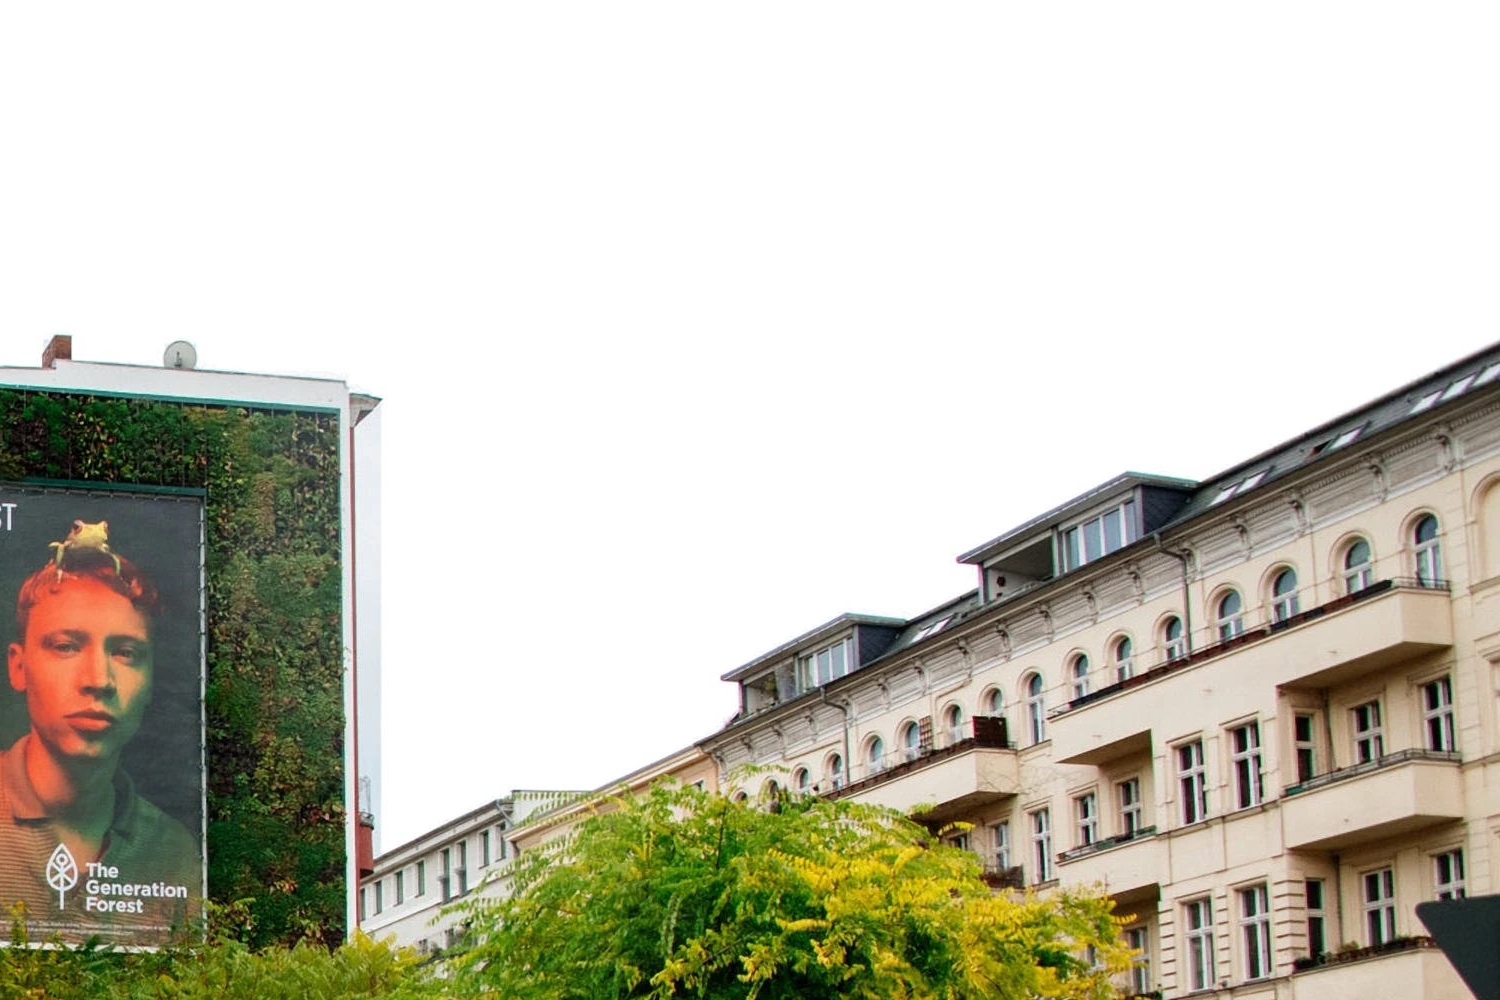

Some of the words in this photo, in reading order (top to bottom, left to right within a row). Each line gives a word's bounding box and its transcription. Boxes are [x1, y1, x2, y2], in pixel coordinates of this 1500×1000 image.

[86, 863, 118, 878] The
[86, 880, 187, 898] Generation
[86, 897, 143, 913] Forest
